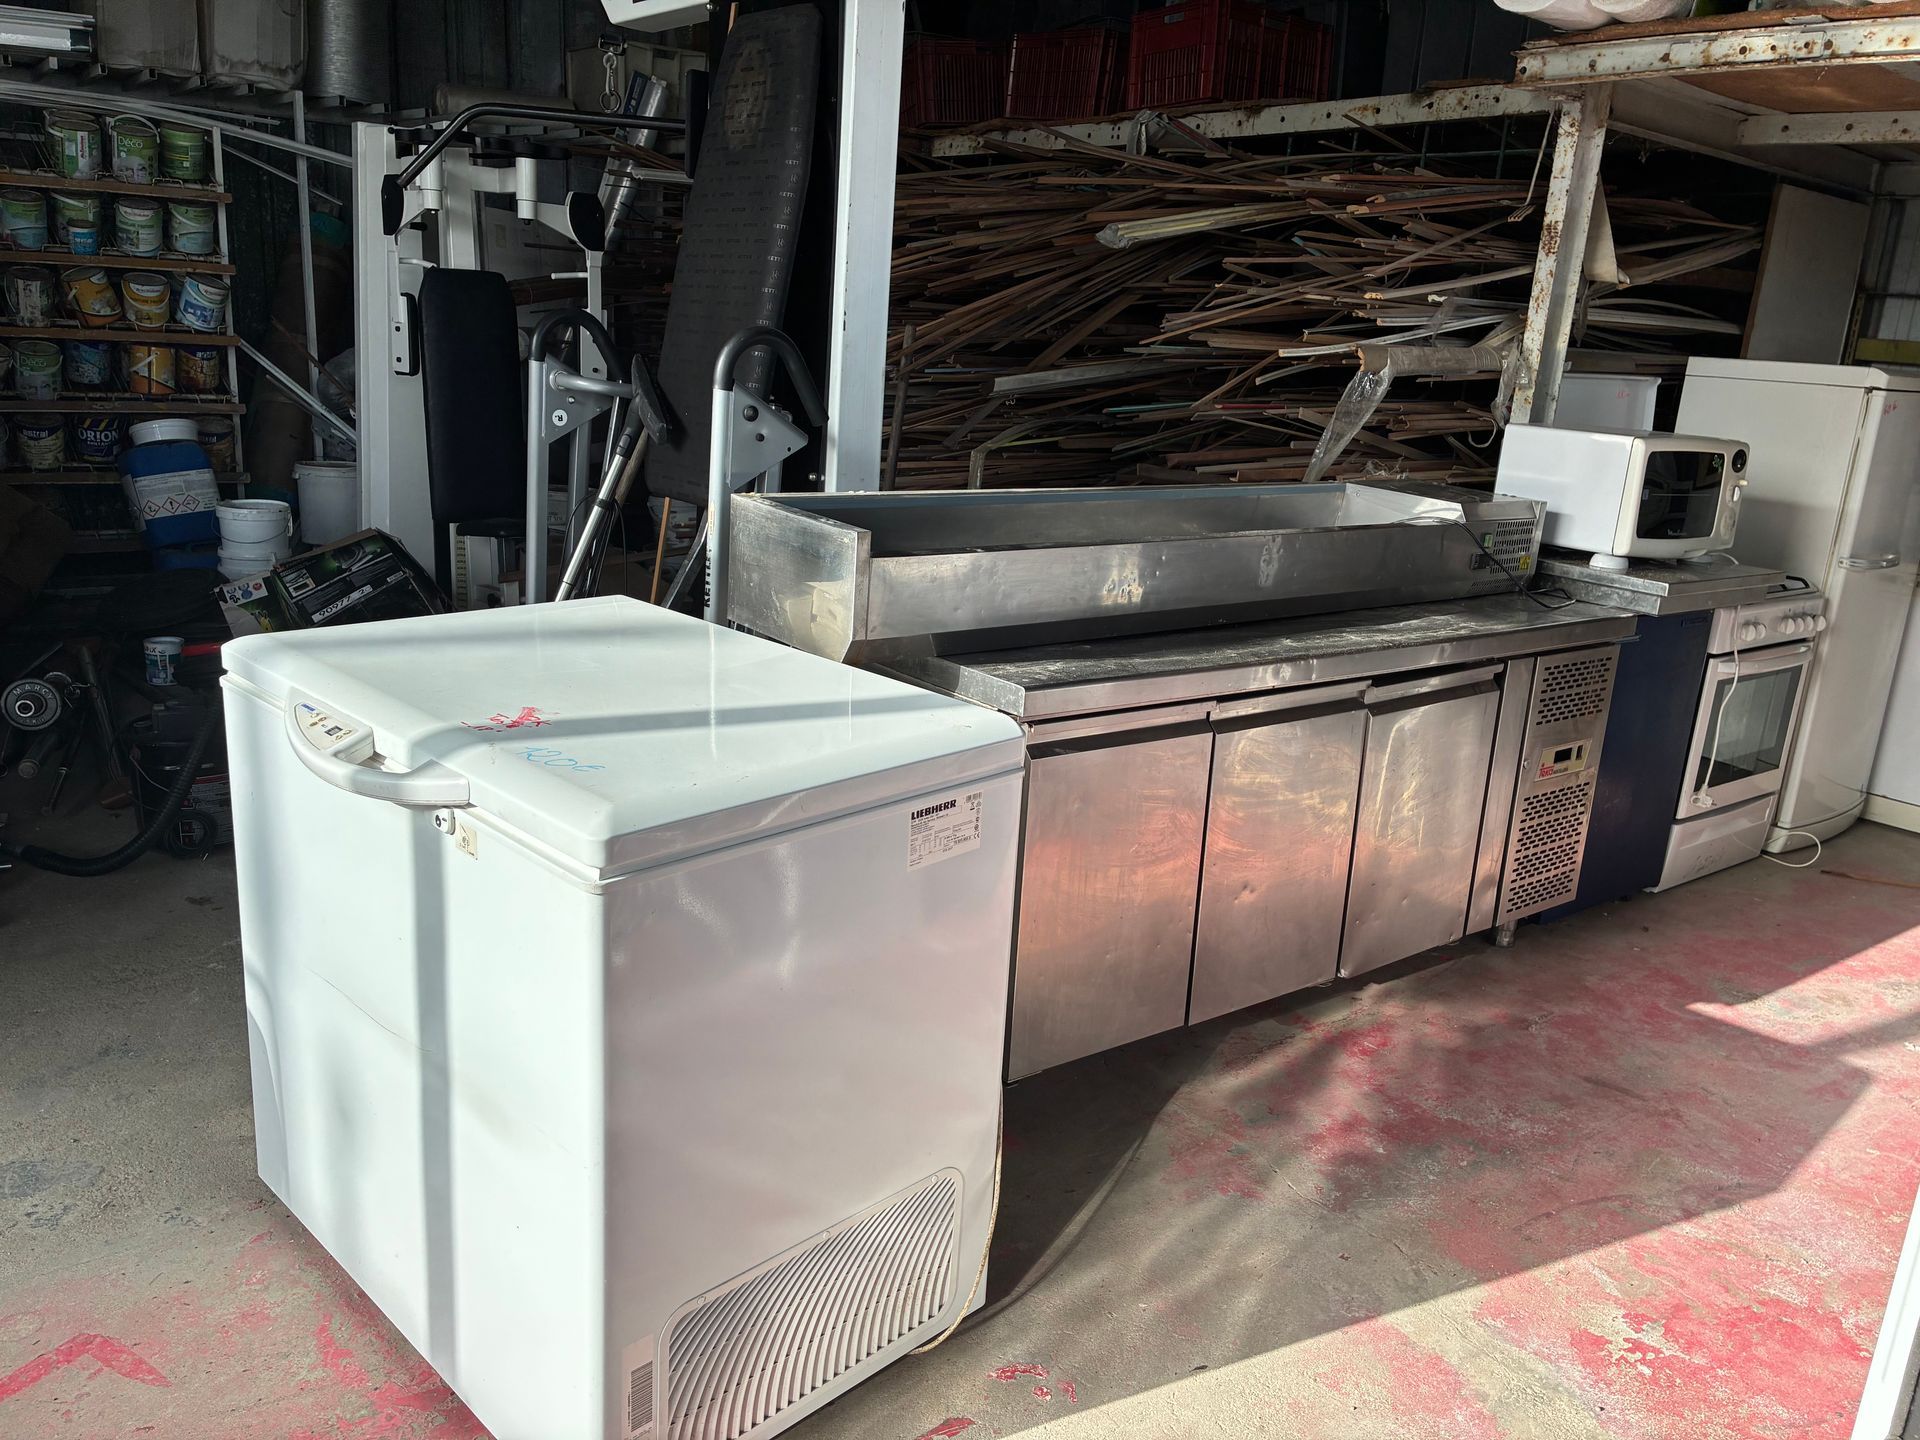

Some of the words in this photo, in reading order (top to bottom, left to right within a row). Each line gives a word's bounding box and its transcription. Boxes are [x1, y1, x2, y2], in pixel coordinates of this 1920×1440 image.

[117, 136, 143, 149] Déco
[78, 428, 119, 442] ORION
[319, 595, 352, 617] 90977
[13, 684, 55, 700] MARCY
[911, 799, 957, 821] LIEBHERR
